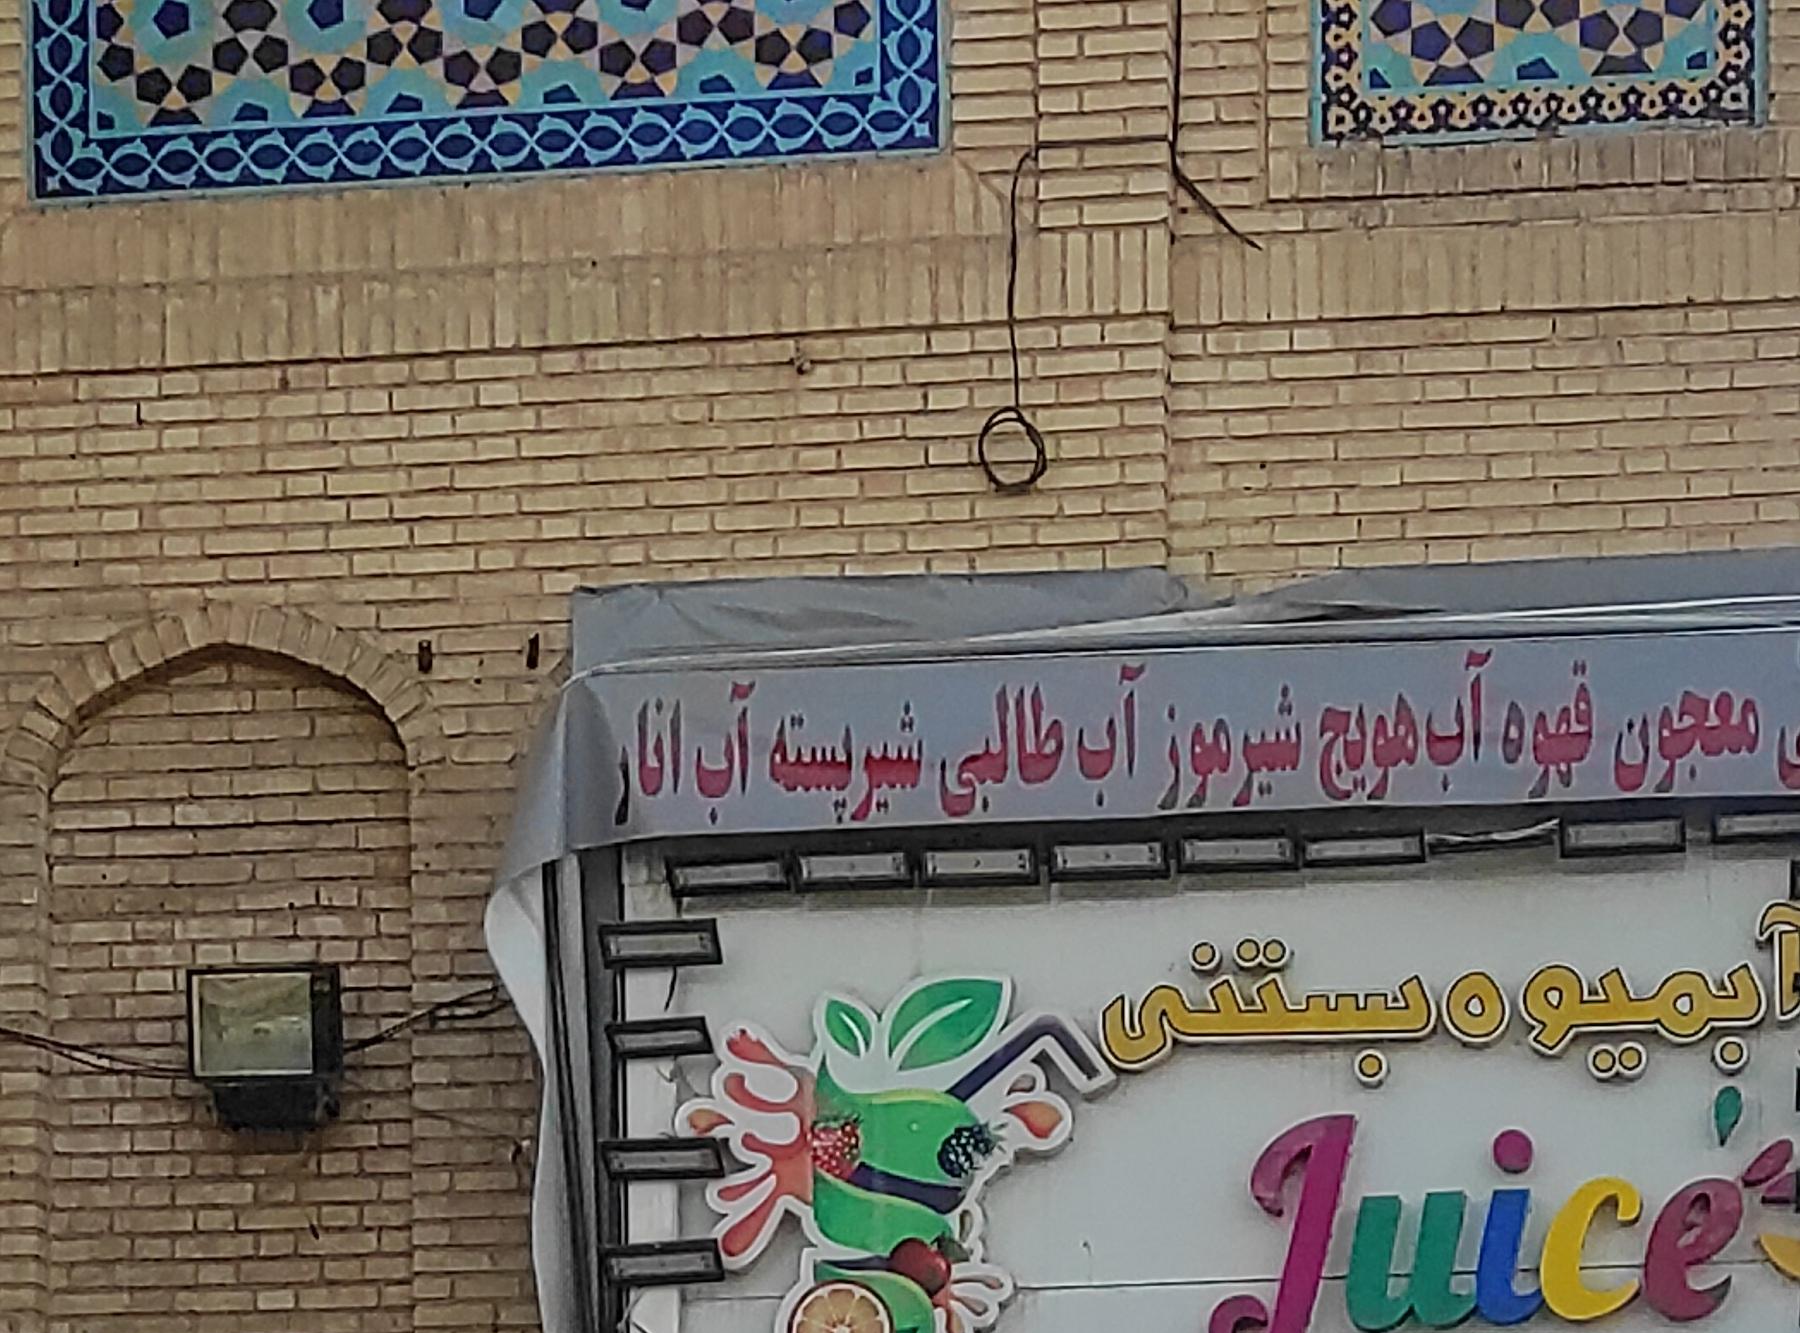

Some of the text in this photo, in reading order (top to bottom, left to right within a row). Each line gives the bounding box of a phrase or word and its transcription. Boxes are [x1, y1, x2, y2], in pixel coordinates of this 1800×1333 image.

[614, 697, 682, 827] انار
[695, 680, 757, 826] آب
[939, 681, 1065, 818] طالبی
[1076, 663, 1147, 808] آب
[1502, 658, 1594, 799] قهوه
[1613, 688, 1760, 794] معجون
[1099, 937, 1438, 1087] بستنی
